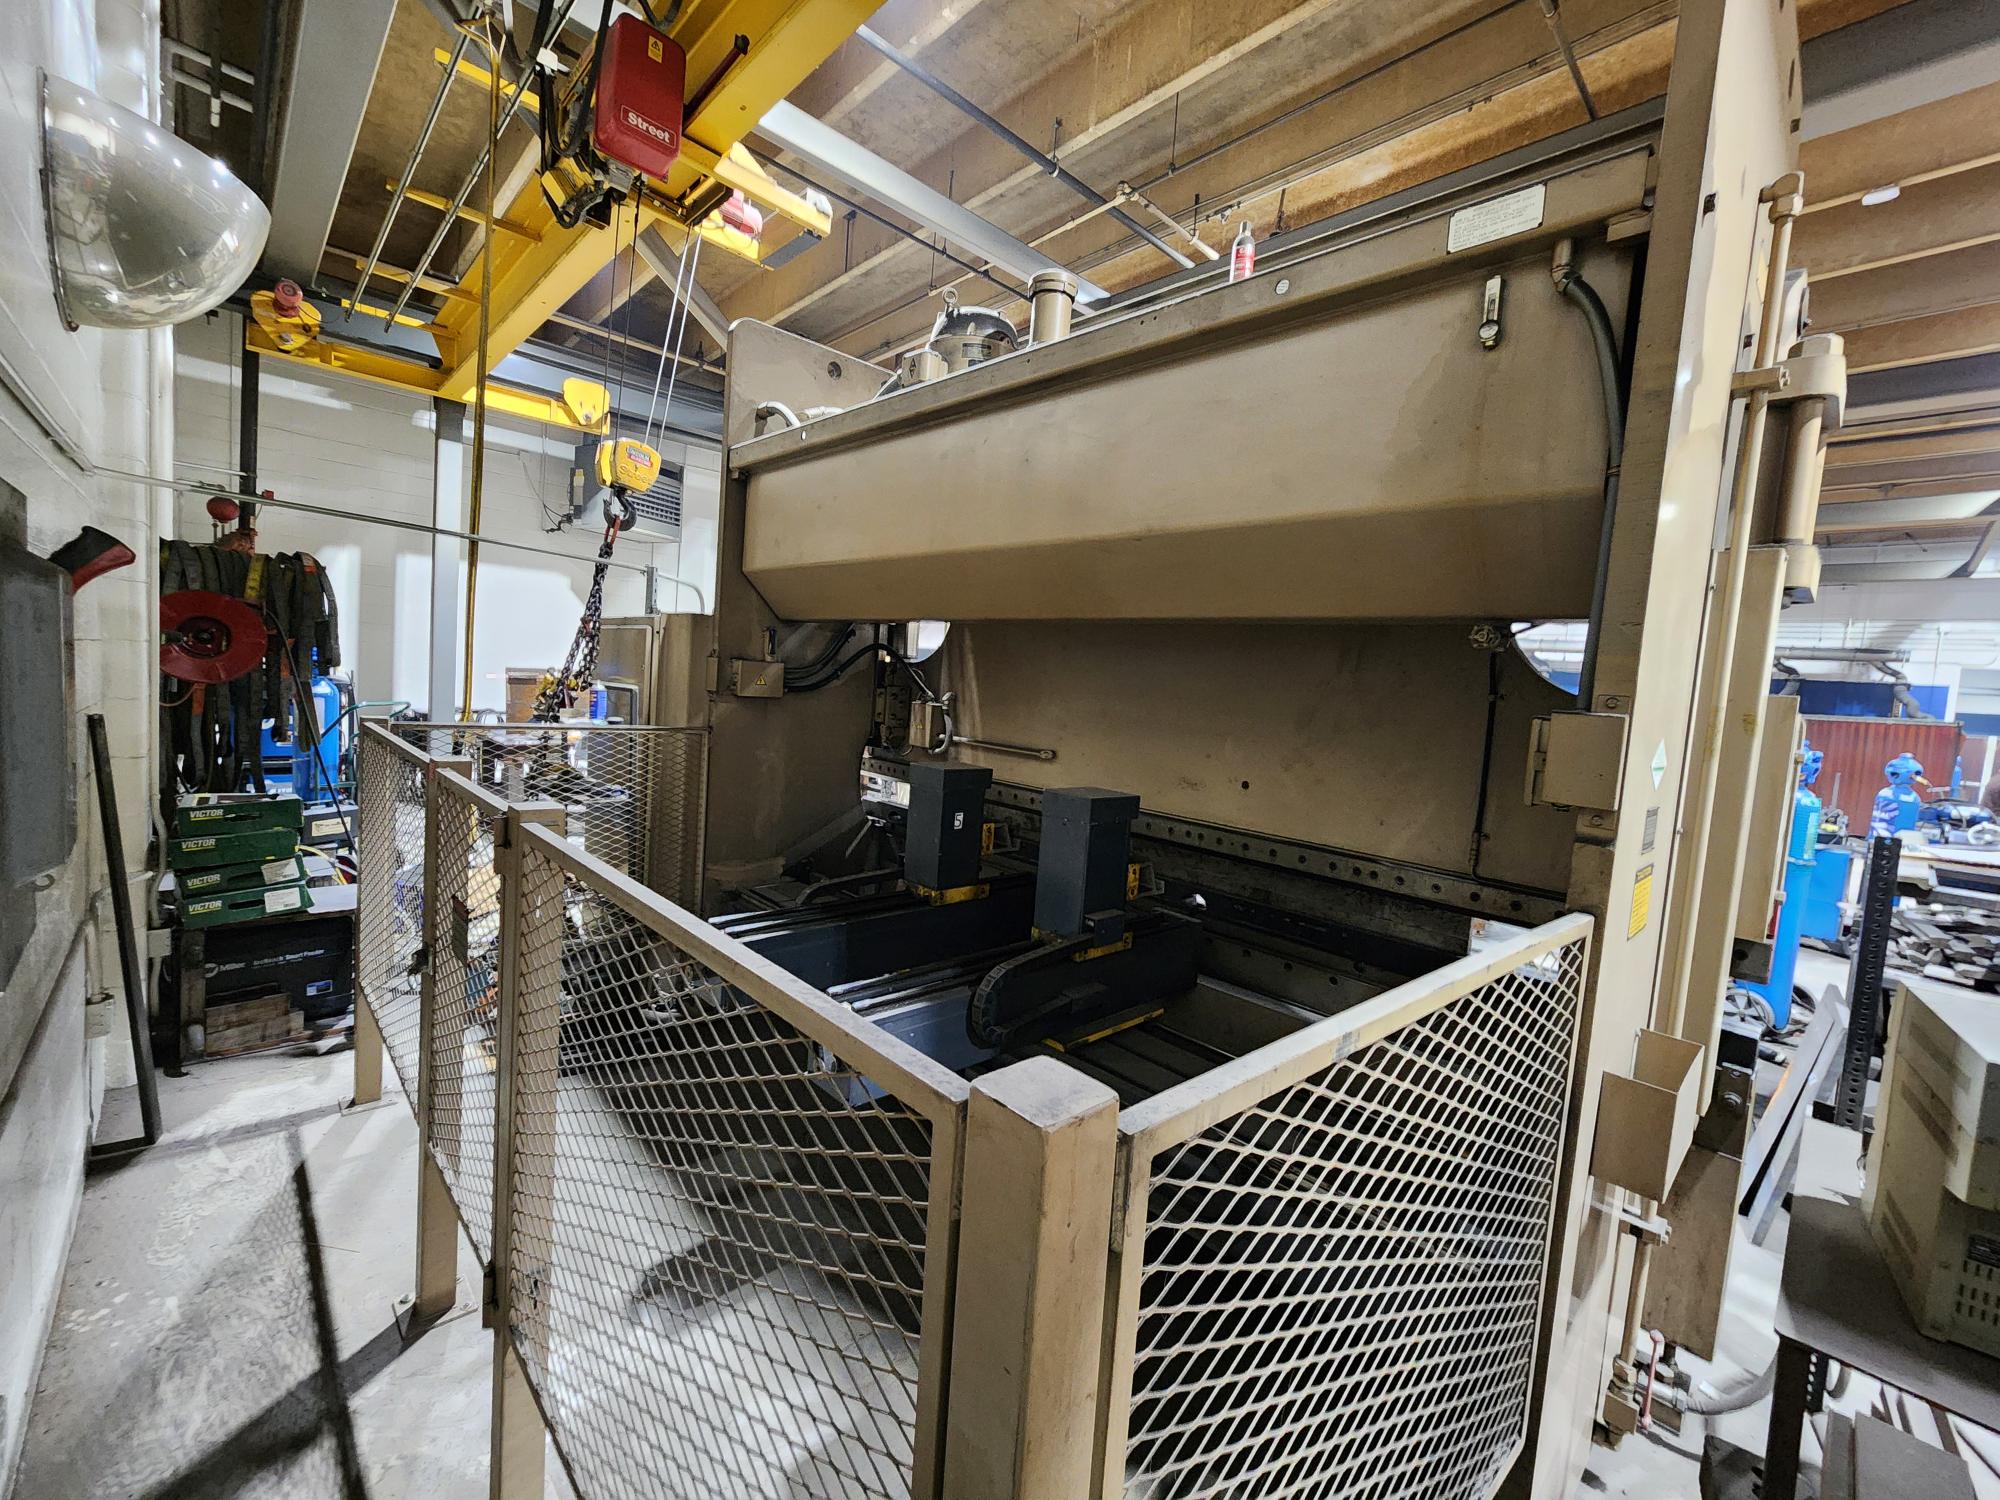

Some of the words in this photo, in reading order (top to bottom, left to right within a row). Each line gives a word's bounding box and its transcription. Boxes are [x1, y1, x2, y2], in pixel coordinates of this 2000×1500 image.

[627, 111, 671, 143] Street
[189, 809, 224, 819] VICTOR
[954, 814, 962, 828] 5
[181, 839, 216, 849] VICTOR
[187, 873, 221, 887] VICTOR
[188, 900, 223, 912] VICTOR
